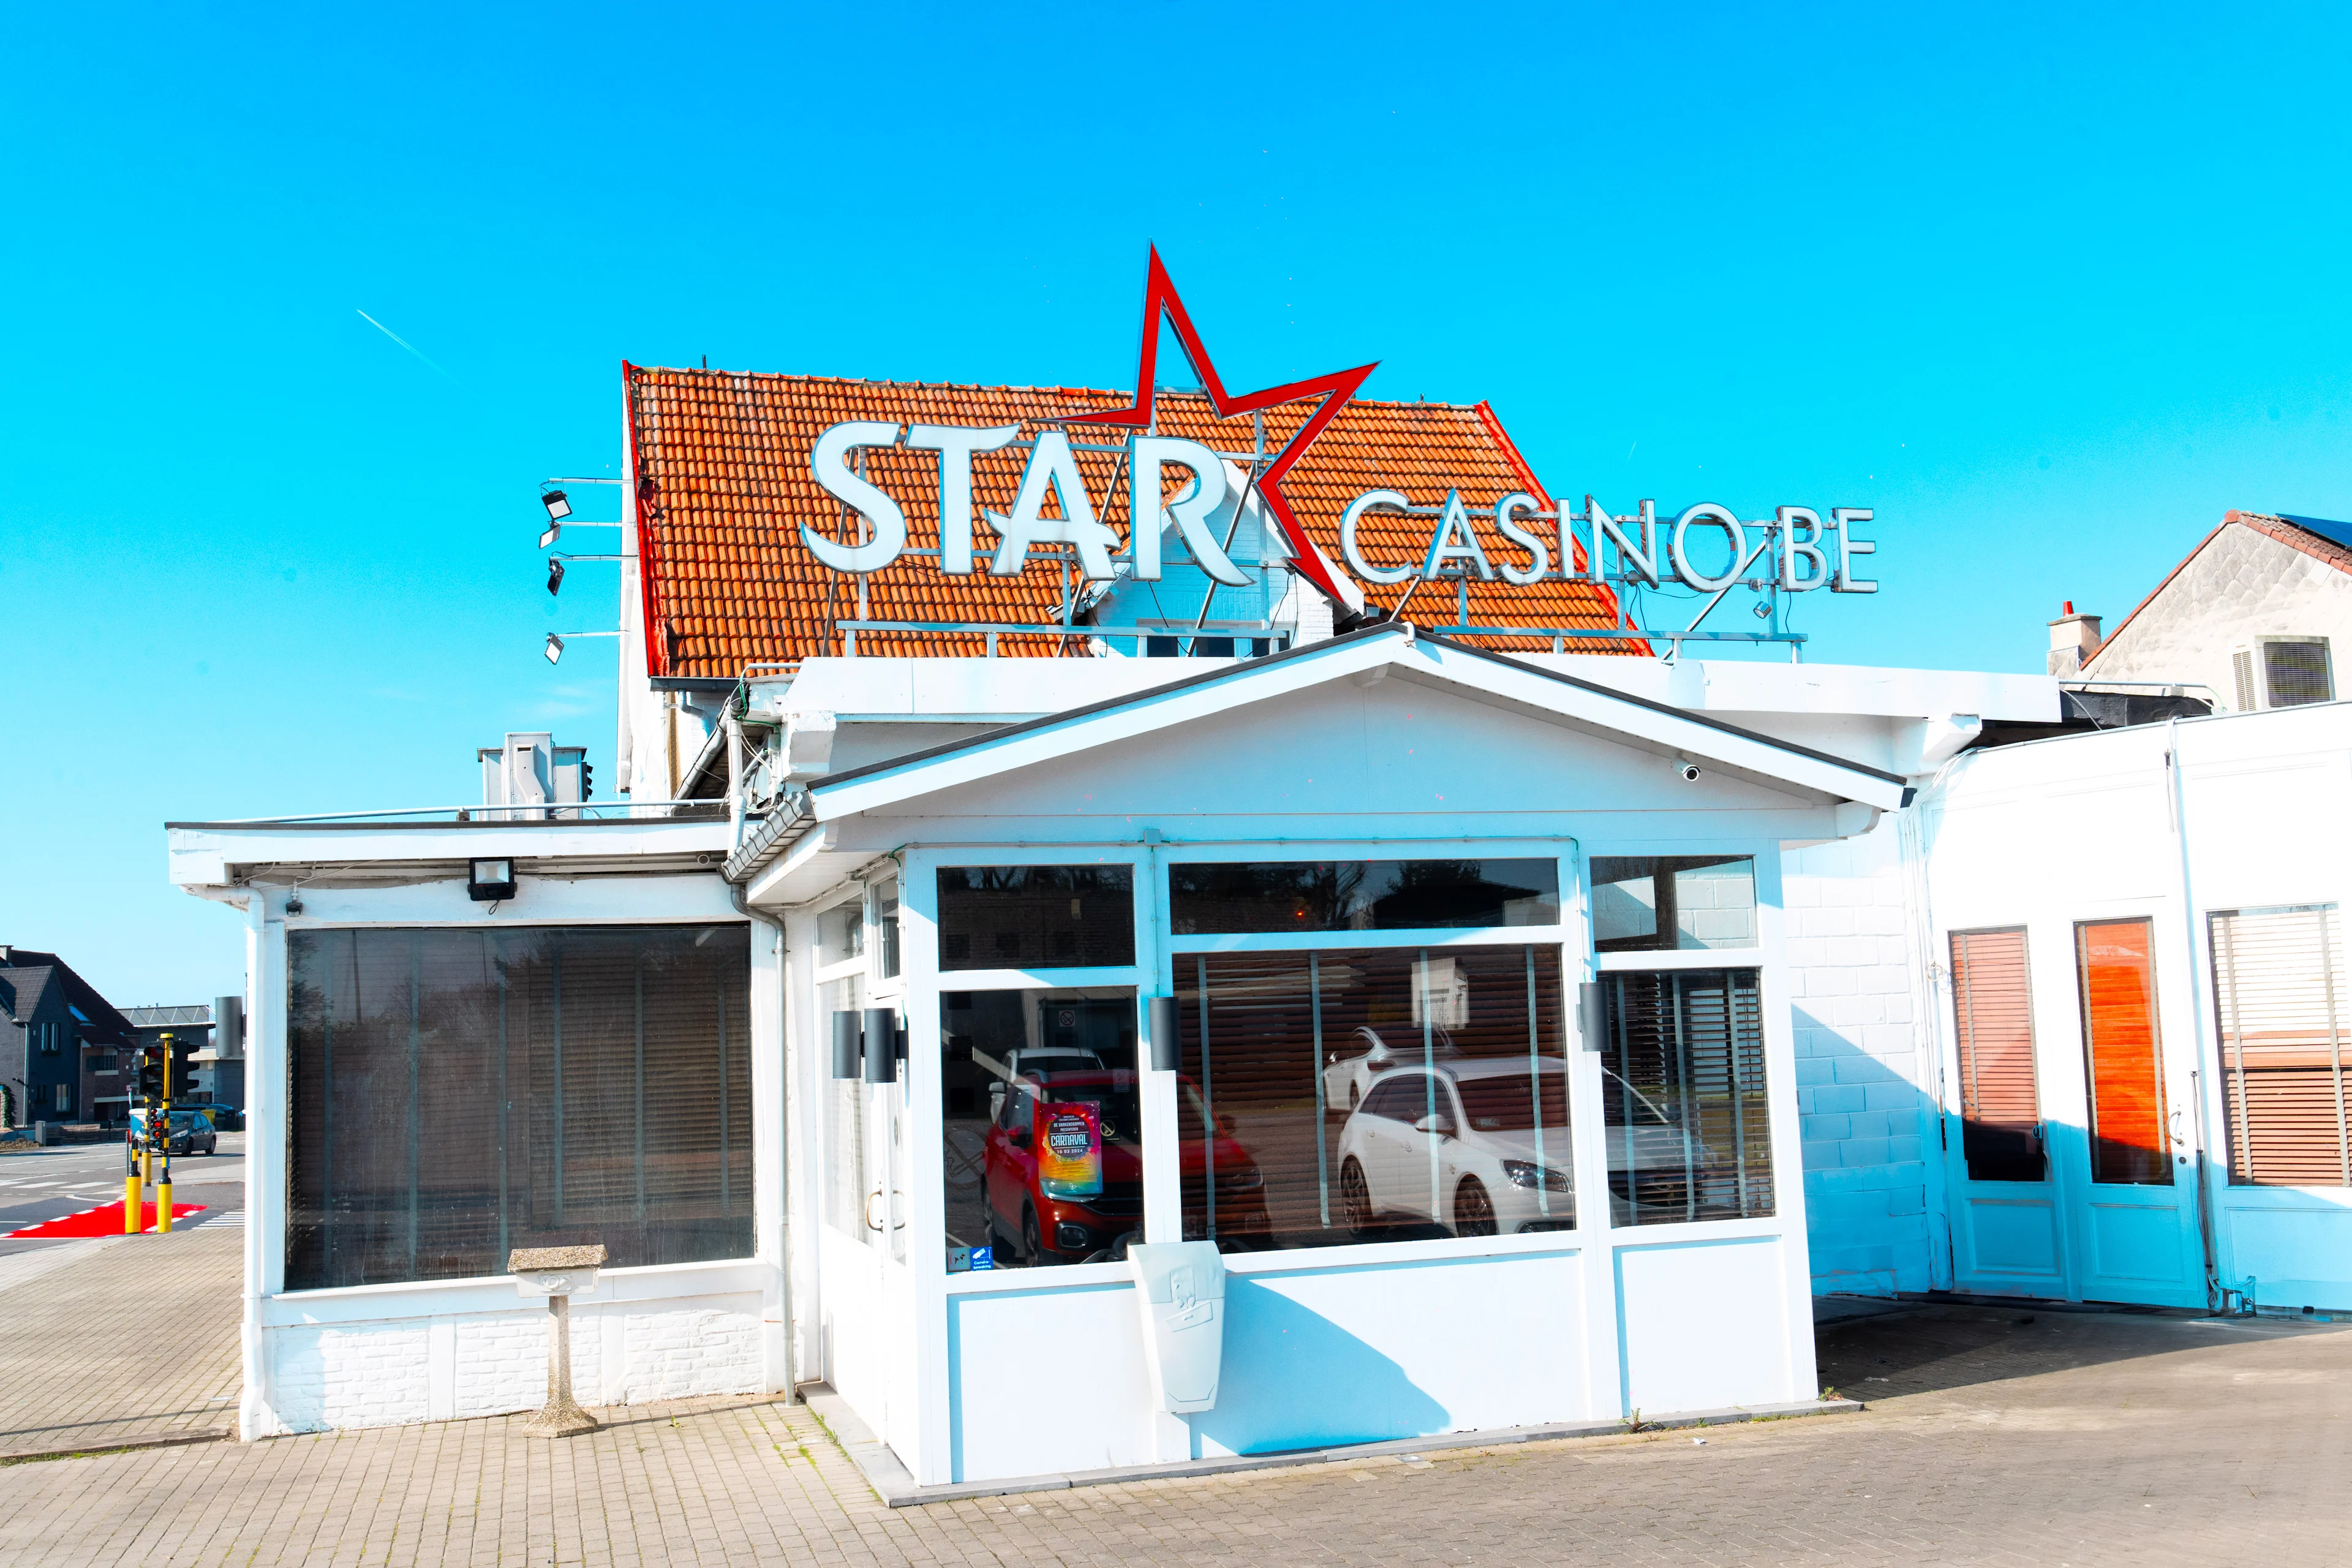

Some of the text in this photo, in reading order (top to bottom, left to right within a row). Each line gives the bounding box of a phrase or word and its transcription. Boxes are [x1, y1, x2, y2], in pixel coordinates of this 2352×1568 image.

[799, 419, 1256, 587] STAR
[1339, 488, 1747, 593] CASINO
[1051, 1134, 1088, 1146] CARNAVAL
